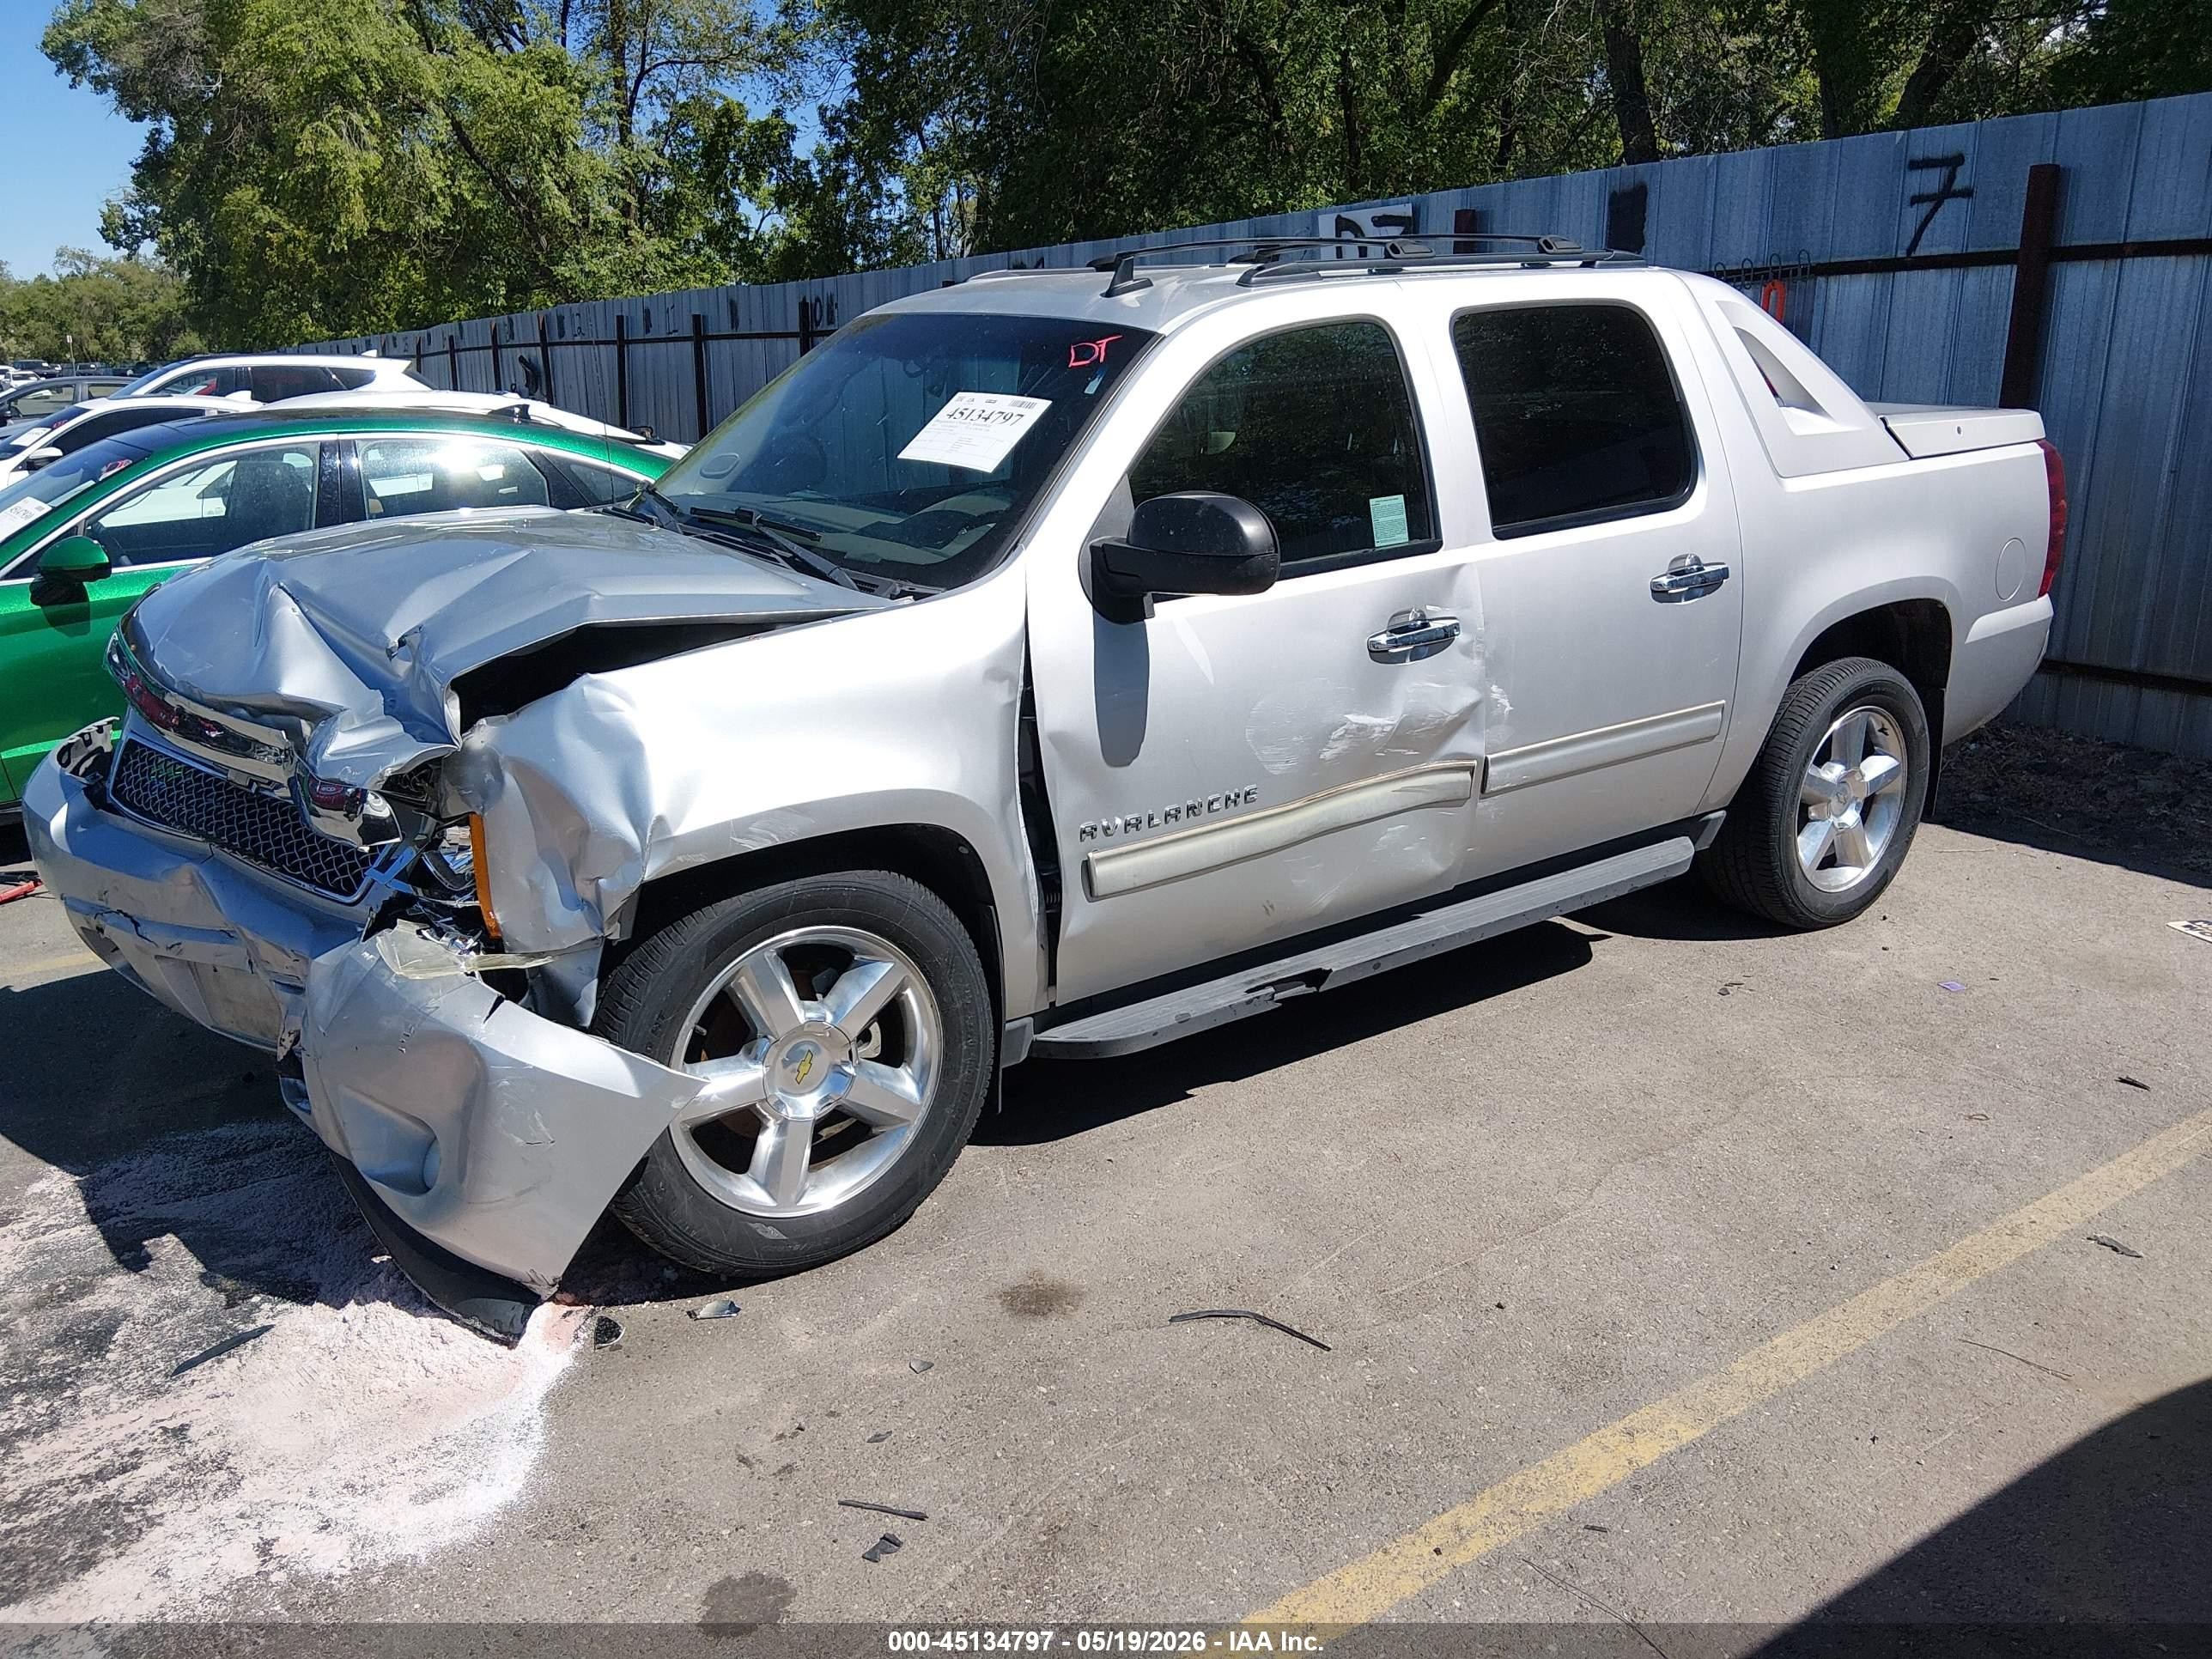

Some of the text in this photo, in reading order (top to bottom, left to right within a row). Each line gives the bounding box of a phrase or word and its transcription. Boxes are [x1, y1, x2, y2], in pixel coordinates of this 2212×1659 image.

[1905, 153, 1972, 257] 7
[1068, 335, 1122, 368] DT
[946, 406, 1025, 427] 45134797
[1079, 783, 1258, 842] AVALANCHE
